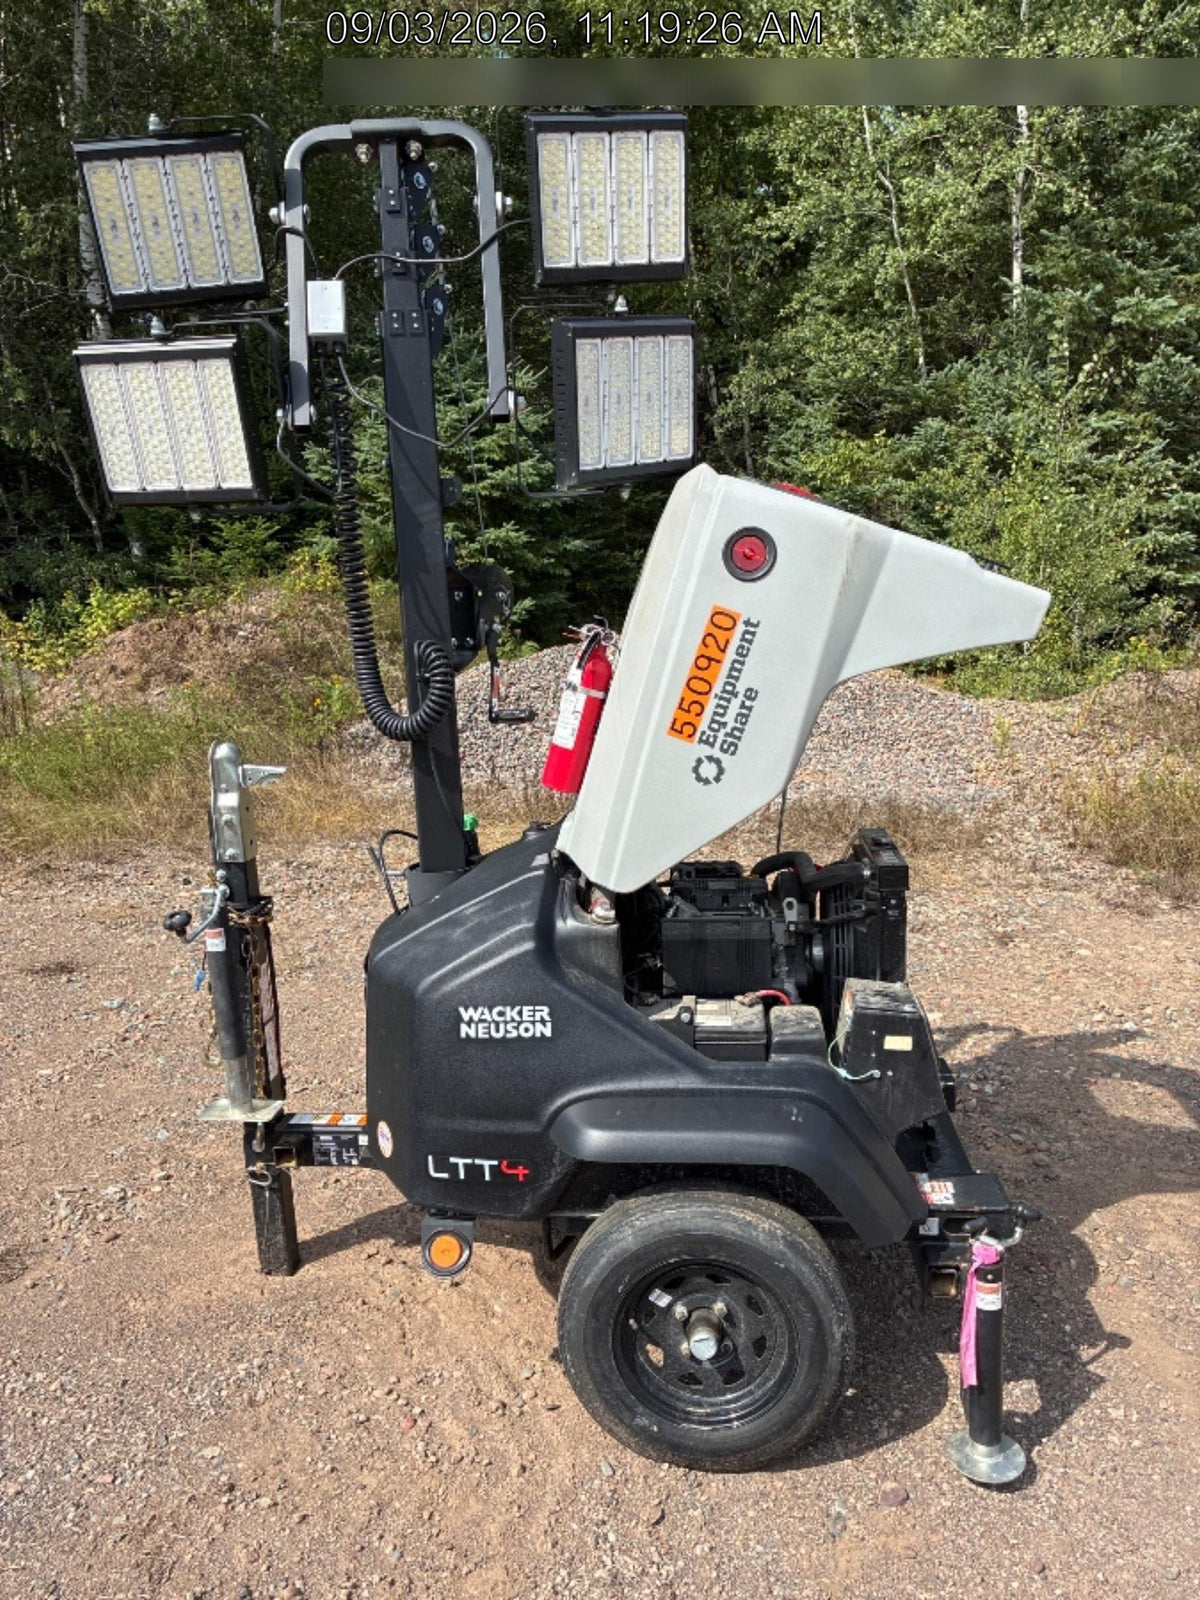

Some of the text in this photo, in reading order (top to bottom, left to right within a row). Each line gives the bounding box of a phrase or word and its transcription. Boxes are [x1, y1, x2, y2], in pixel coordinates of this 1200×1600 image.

[670, 610, 738, 739] 550920
[697, 616, 761, 750] Equipment
[719, 686, 760, 757] Share
[458, 1005, 552, 1022] WACKER
[459, 1022, 552, 1038] NEUSON
[427, 1154, 530, 1182] LTT4
